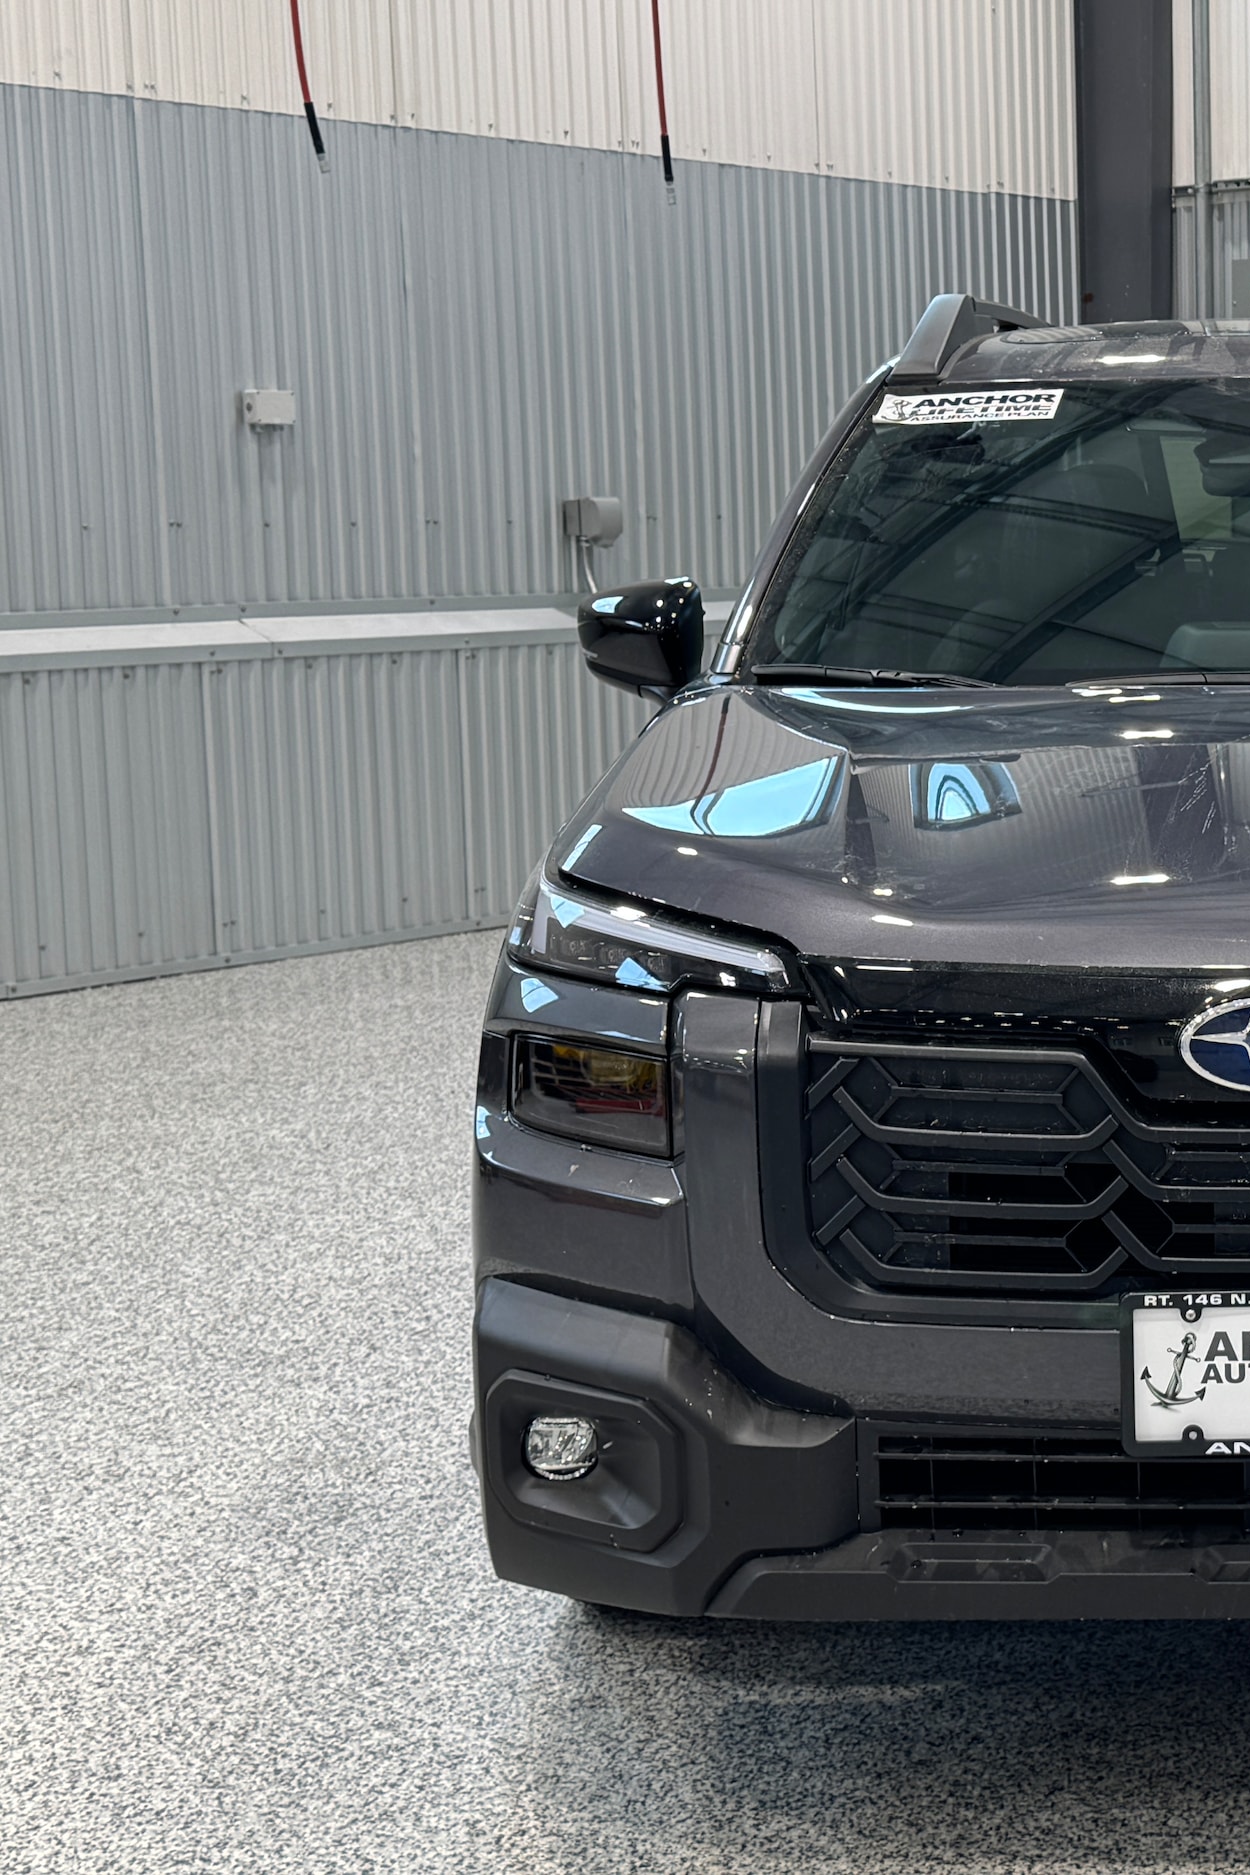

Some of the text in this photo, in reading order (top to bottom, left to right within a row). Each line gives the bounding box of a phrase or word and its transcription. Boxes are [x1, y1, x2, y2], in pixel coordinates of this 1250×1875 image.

[912, 393, 1057, 408] ANCHOR
[909, 410, 1050, 422] ASSURANCE PLAN
[1144, 1294, 1174, 1307] RT.
[1183, 1293, 1223, 1306] 146
